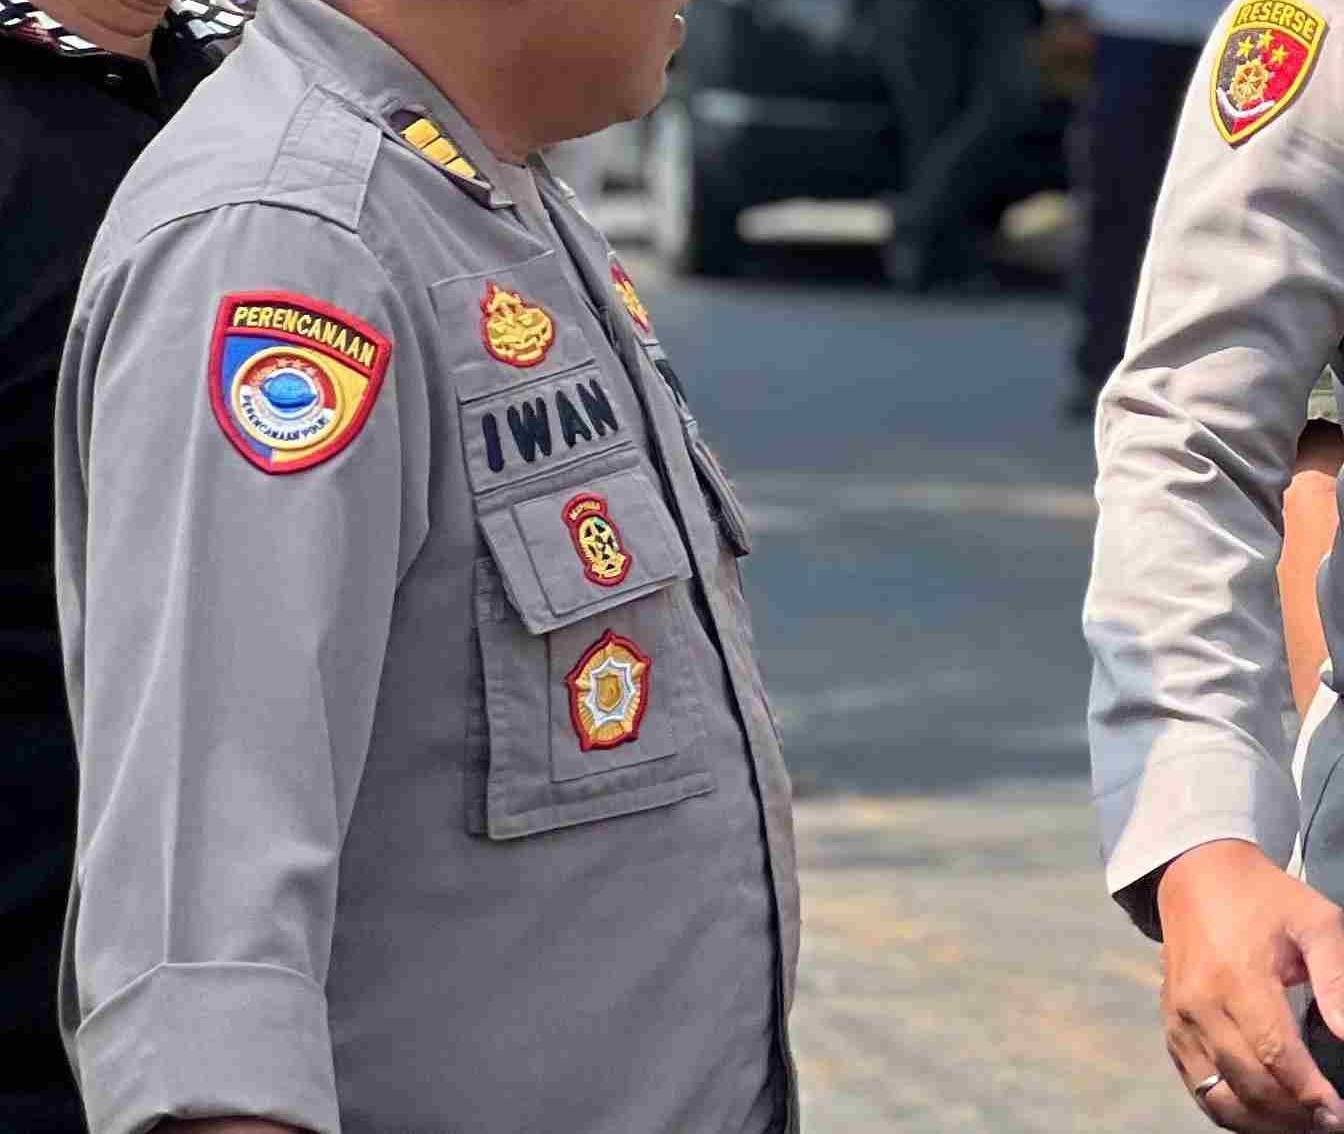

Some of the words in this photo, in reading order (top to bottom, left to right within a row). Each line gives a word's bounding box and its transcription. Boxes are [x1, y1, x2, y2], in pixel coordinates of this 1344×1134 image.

[1236, 1, 1317, 40] RESERSE
[233, 306, 375, 366] PERENCANAAN
[481, 378, 620, 473] IWAN
